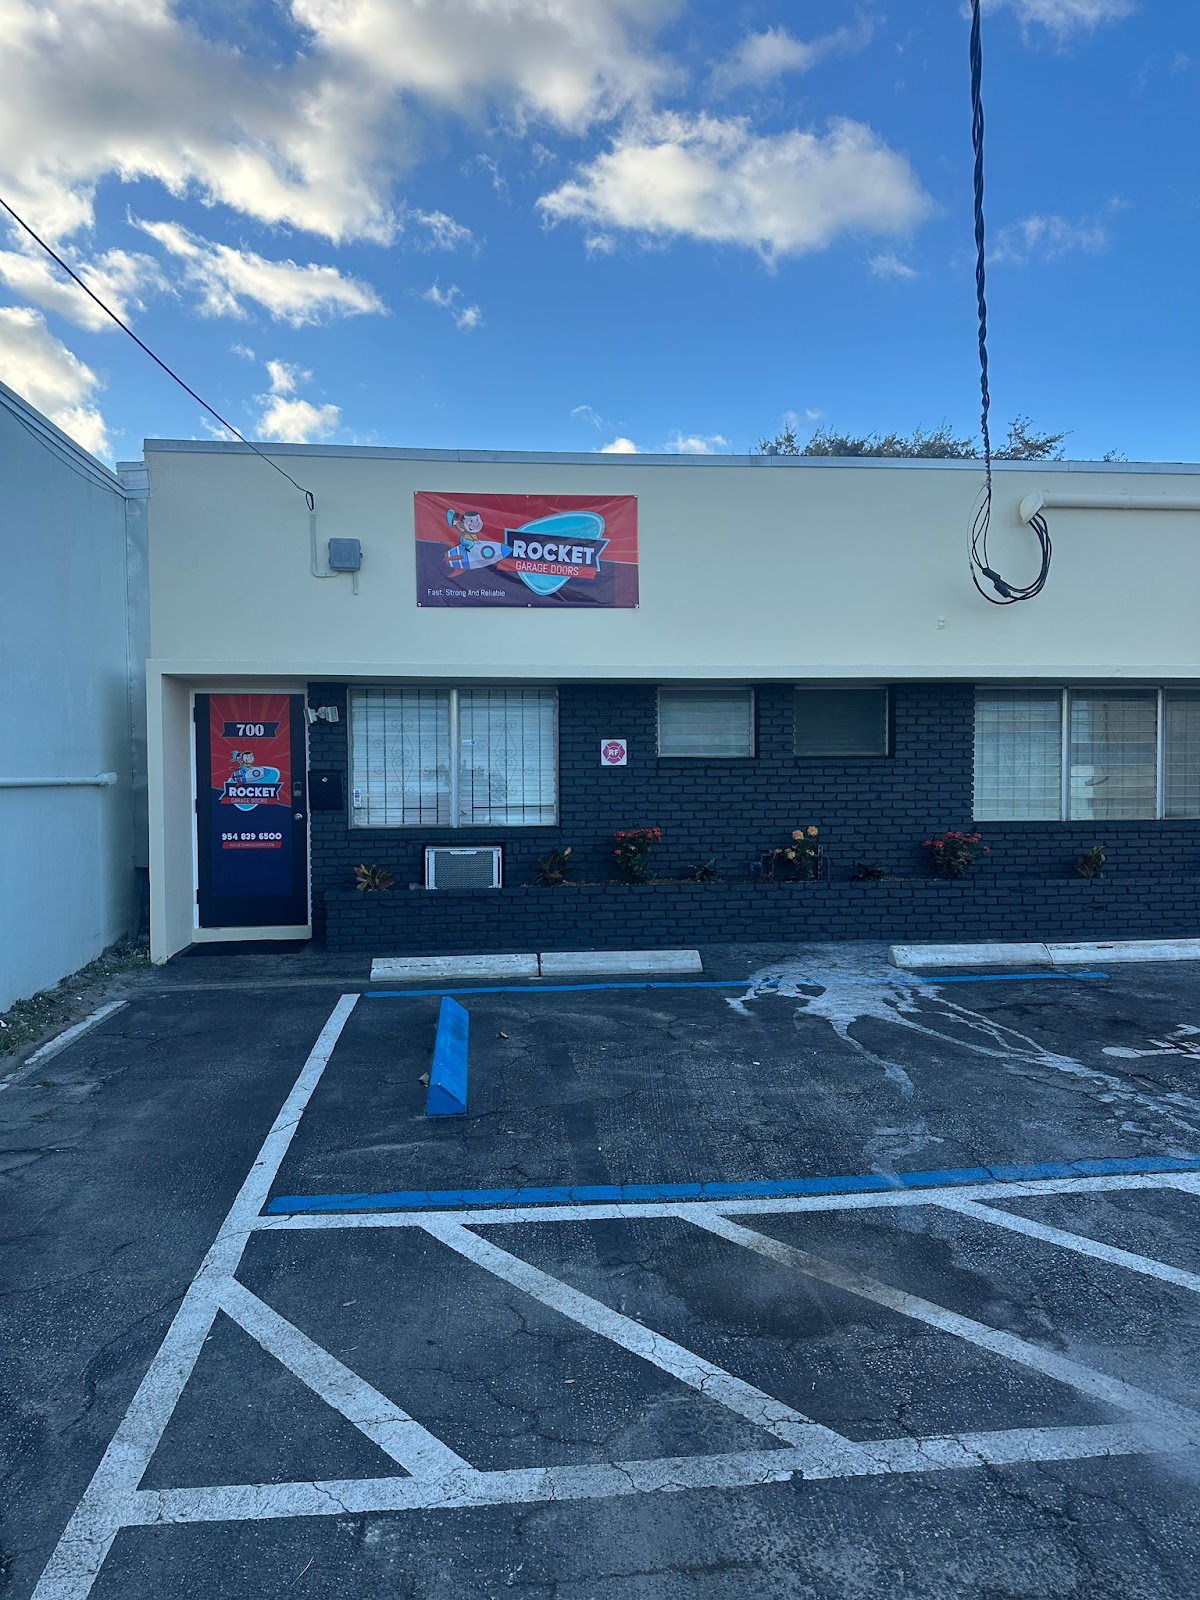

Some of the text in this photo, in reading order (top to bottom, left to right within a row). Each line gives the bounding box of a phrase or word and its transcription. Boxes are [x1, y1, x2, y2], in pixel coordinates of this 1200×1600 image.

[512, 540, 595, 564] ROCKET
[515, 561, 579, 576] GARAGE DOORS
[445, 588, 467, 598] Strong
[467, 589, 480, 597] And
[480, 589, 506, 597] Reliable
[236, 724, 265, 736] 700
[228, 786, 276, 797] ROCKET
[222, 832, 238, 840] 954
[258, 832, 282, 840] 6500
